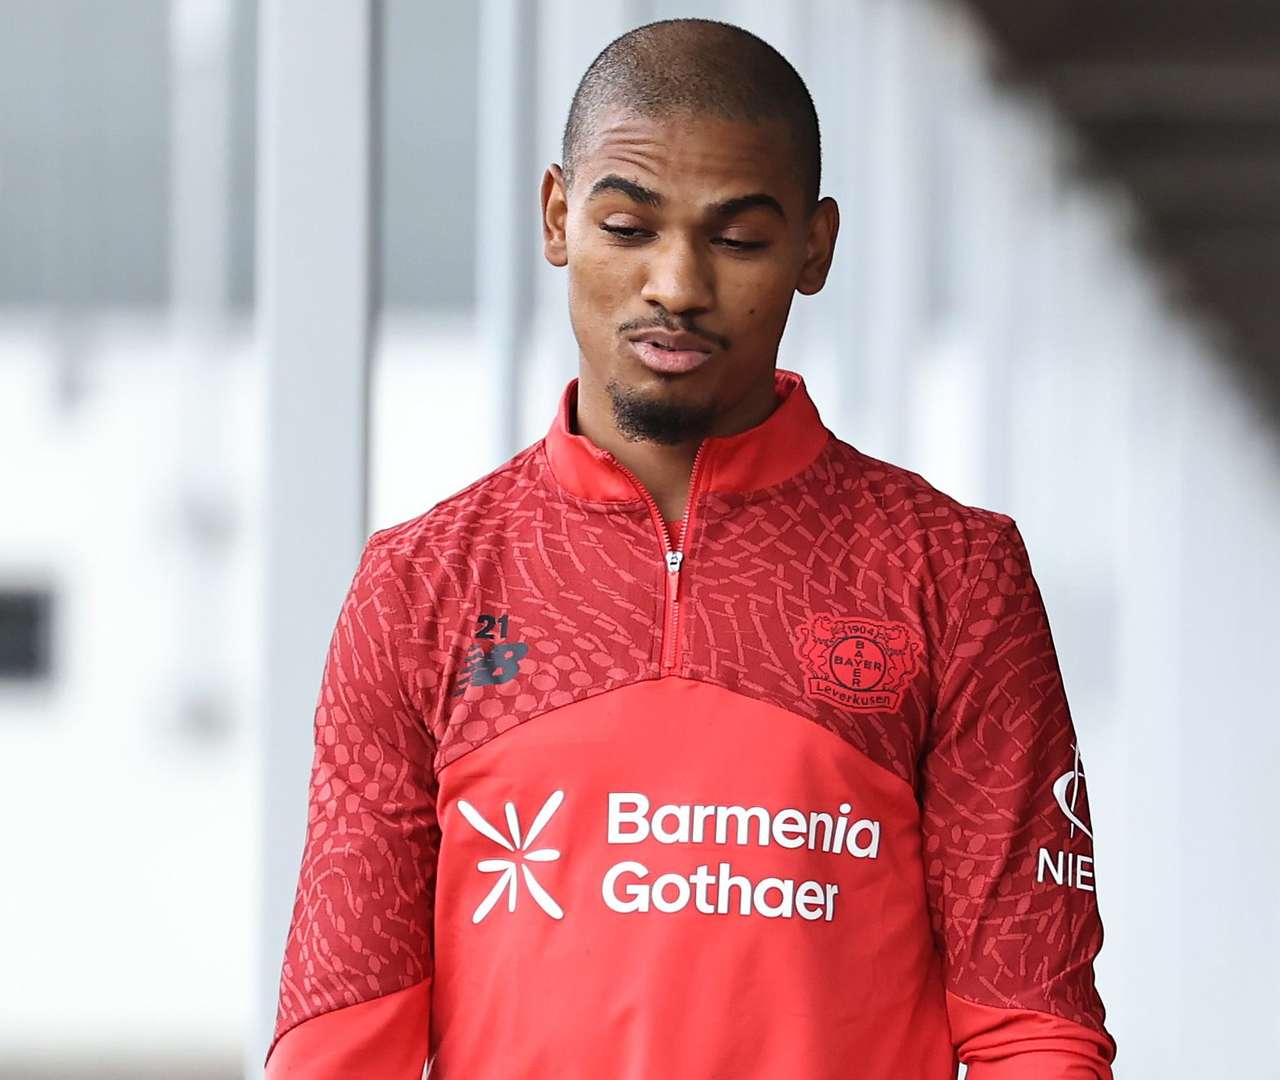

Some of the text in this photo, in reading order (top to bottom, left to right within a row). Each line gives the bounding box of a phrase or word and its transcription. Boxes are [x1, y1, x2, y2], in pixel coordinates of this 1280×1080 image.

[475, 614, 509, 639] 21
[834, 655, 882, 672] BAYER
[816, 680, 890, 706] Leverkusen
[607, 791, 881, 859] Barmenia
[602, 861, 839, 921] Gothaer
